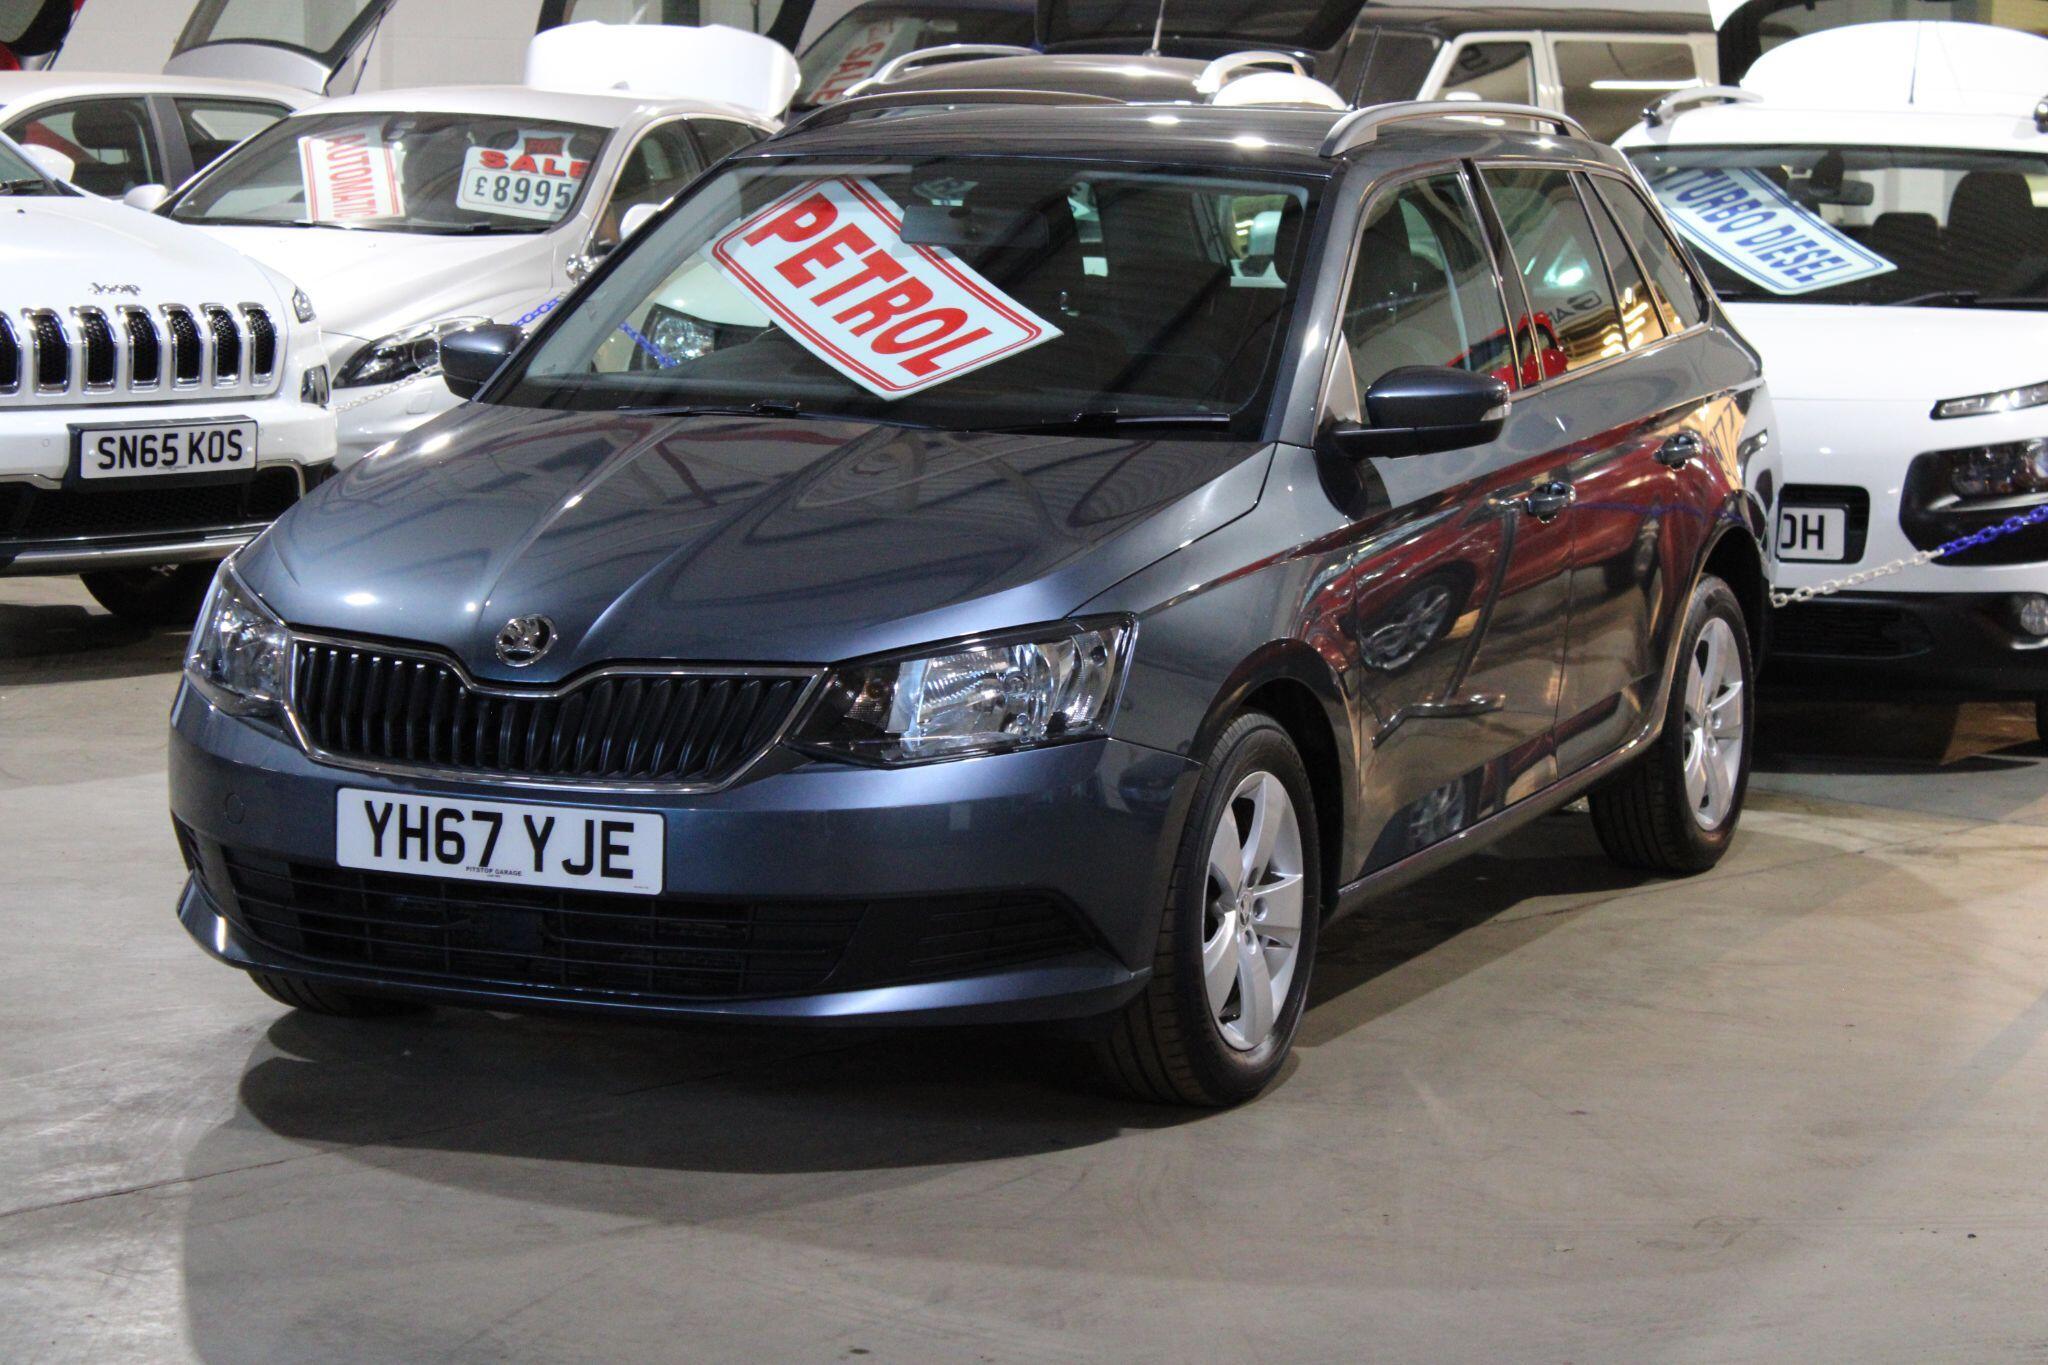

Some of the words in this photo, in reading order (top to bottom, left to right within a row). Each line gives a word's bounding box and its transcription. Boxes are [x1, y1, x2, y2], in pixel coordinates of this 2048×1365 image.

[809, 41, 886, 104] SALE
[326, 133, 377, 218] AUTOMATIC
[474, 175, 572, 209] £8995
[479, 150, 590, 179] SALE
[1665, 168, 1776, 232] TURBO
[1735, 224, 1851, 282] DIESEL
[742, 192, 993, 377] PETROL
[97, 433, 178, 470] SN65
[188, 429, 243, 464] KOS
[364, 800, 503, 867] YH67
[523, 814, 634, 879] YJE
[465, 866, 493, 875] PITSTOP
[494, 868, 523, 877] GARAGE
